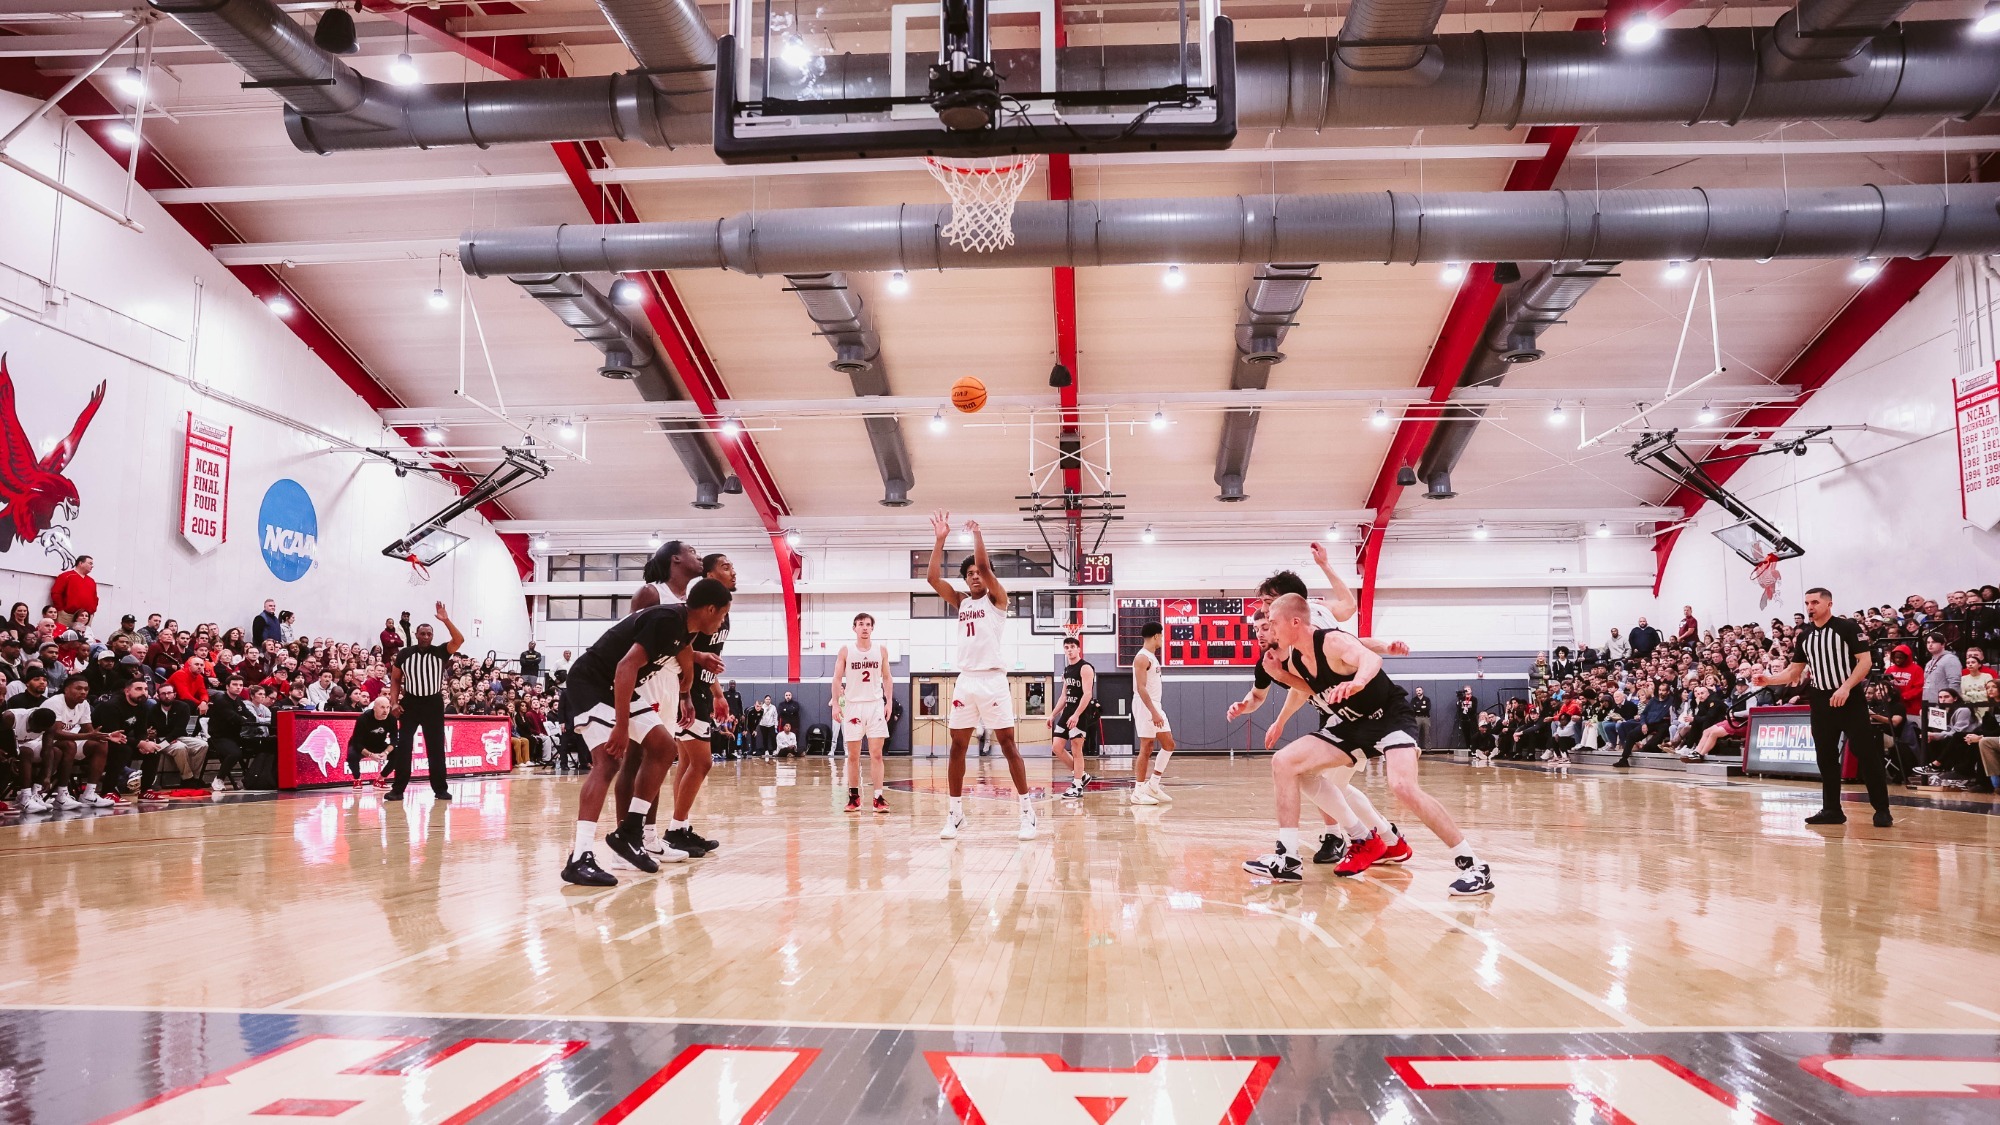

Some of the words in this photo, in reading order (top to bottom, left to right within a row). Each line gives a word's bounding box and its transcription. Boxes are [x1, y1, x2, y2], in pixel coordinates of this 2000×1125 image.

[1967, 404, 1991, 423] NCAA
[1962, 415, 1998, 434] TOURNAMENT
[1962, 432, 1978, 446] 1969
[1982, 427, 1999, 440] 1970
[1963, 445, 1979, 458] 1971
[1983, 439, 2000, 452] 1981
[195, 457, 220, 478] NCAA
[1964, 457, 1980, 470] 1982
[1965, 468, 1981, 481] 1994
[193, 475, 220, 495] FINAL
[1966, 480, 1982, 493] 2003
[1986, 476, 2000, 488] 202
[194, 493, 217, 512] FOUR
[191, 516, 217, 537] 2015
[263, 524, 318, 561] NCAA
[1085, 555, 1110, 566] 14:28
[1084, 566, 1106, 582] 30
[1121, 599, 1134, 608] PLY
[1135, 599, 1144, 608] FL
[1145, 599, 1158, 608] PTS
[1165, 616, 1200, 624] MONTCLAIR
[966, 621, 976, 638] 11
[851, 661, 862, 670] RED
[862, 660, 879, 669] HAWKS
[861, 670, 871, 683] 2
[1757, 725, 1786, 748] RED
[463, 756, 482, 768] CENTER
[1759, 749, 1788, 761] SPORTS
